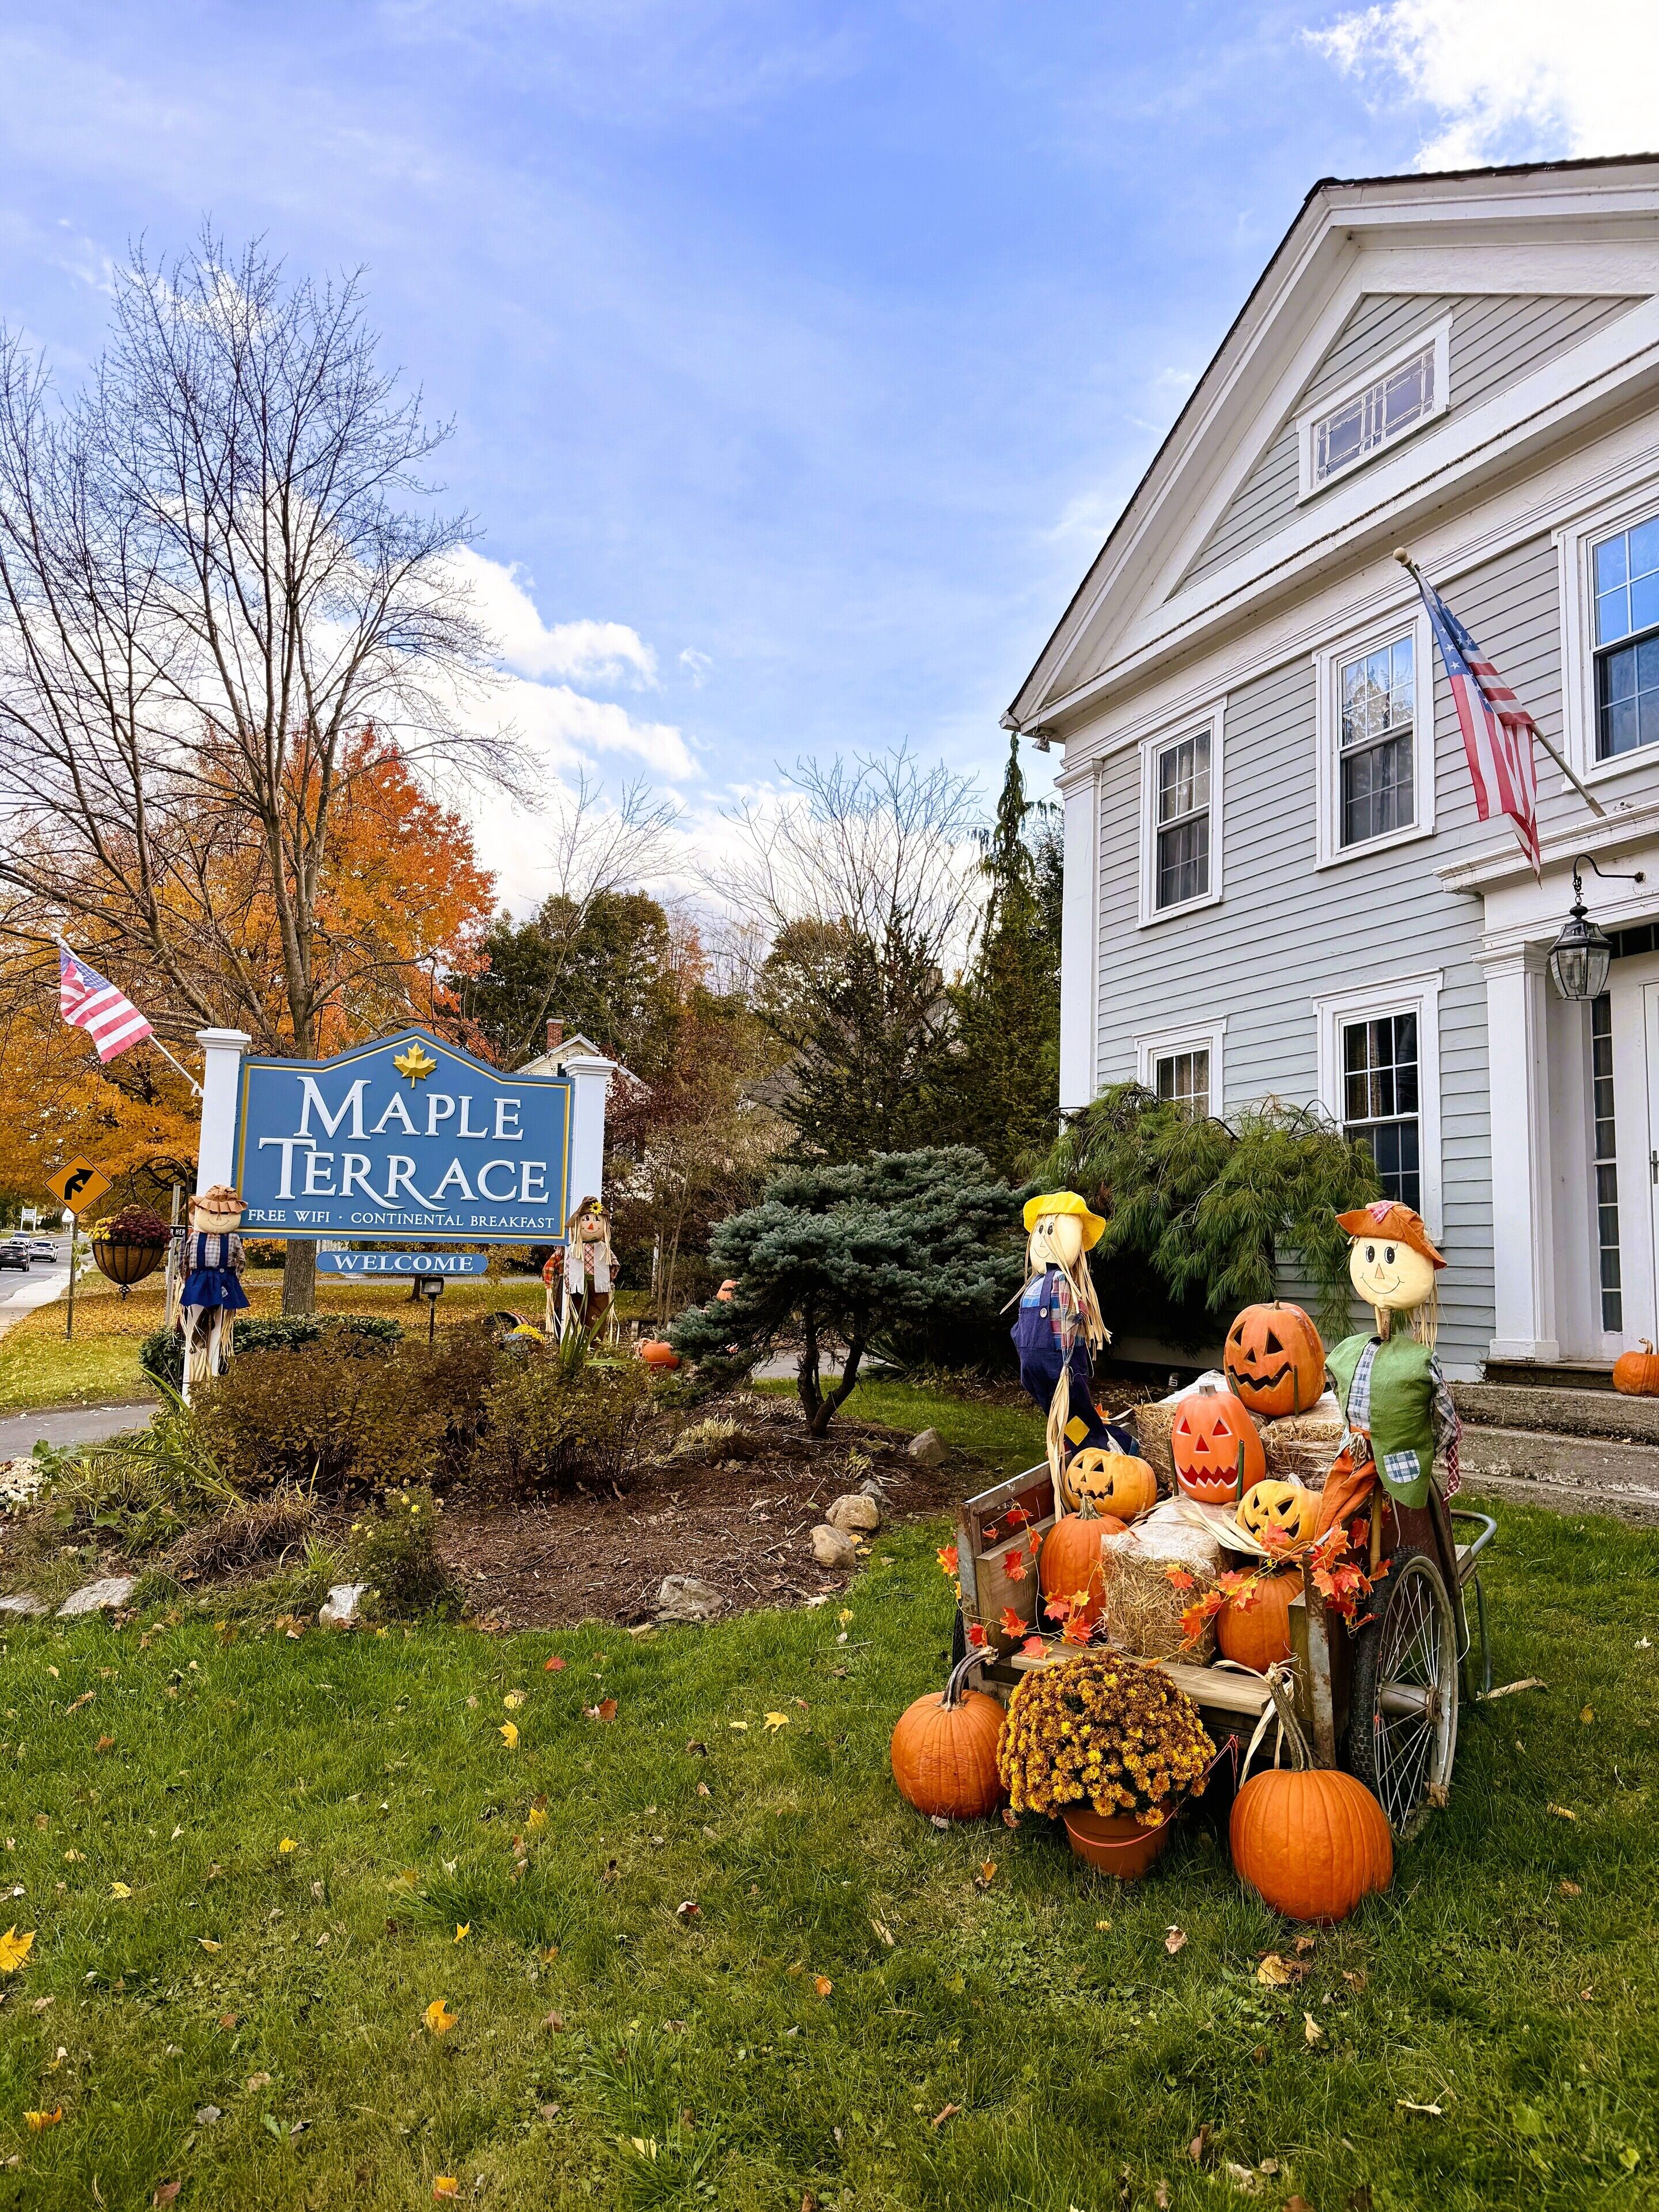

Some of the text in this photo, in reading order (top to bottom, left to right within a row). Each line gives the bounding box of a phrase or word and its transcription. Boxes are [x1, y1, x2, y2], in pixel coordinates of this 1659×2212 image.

[293, 1077, 524, 1140] MAPLE
[258, 1137, 550, 1211] TERRACE
[248, 1209, 554, 1228] FREE WIFI CONTINENTAL BREAKFAST
[332, 1255, 474, 1271] WELCOME
